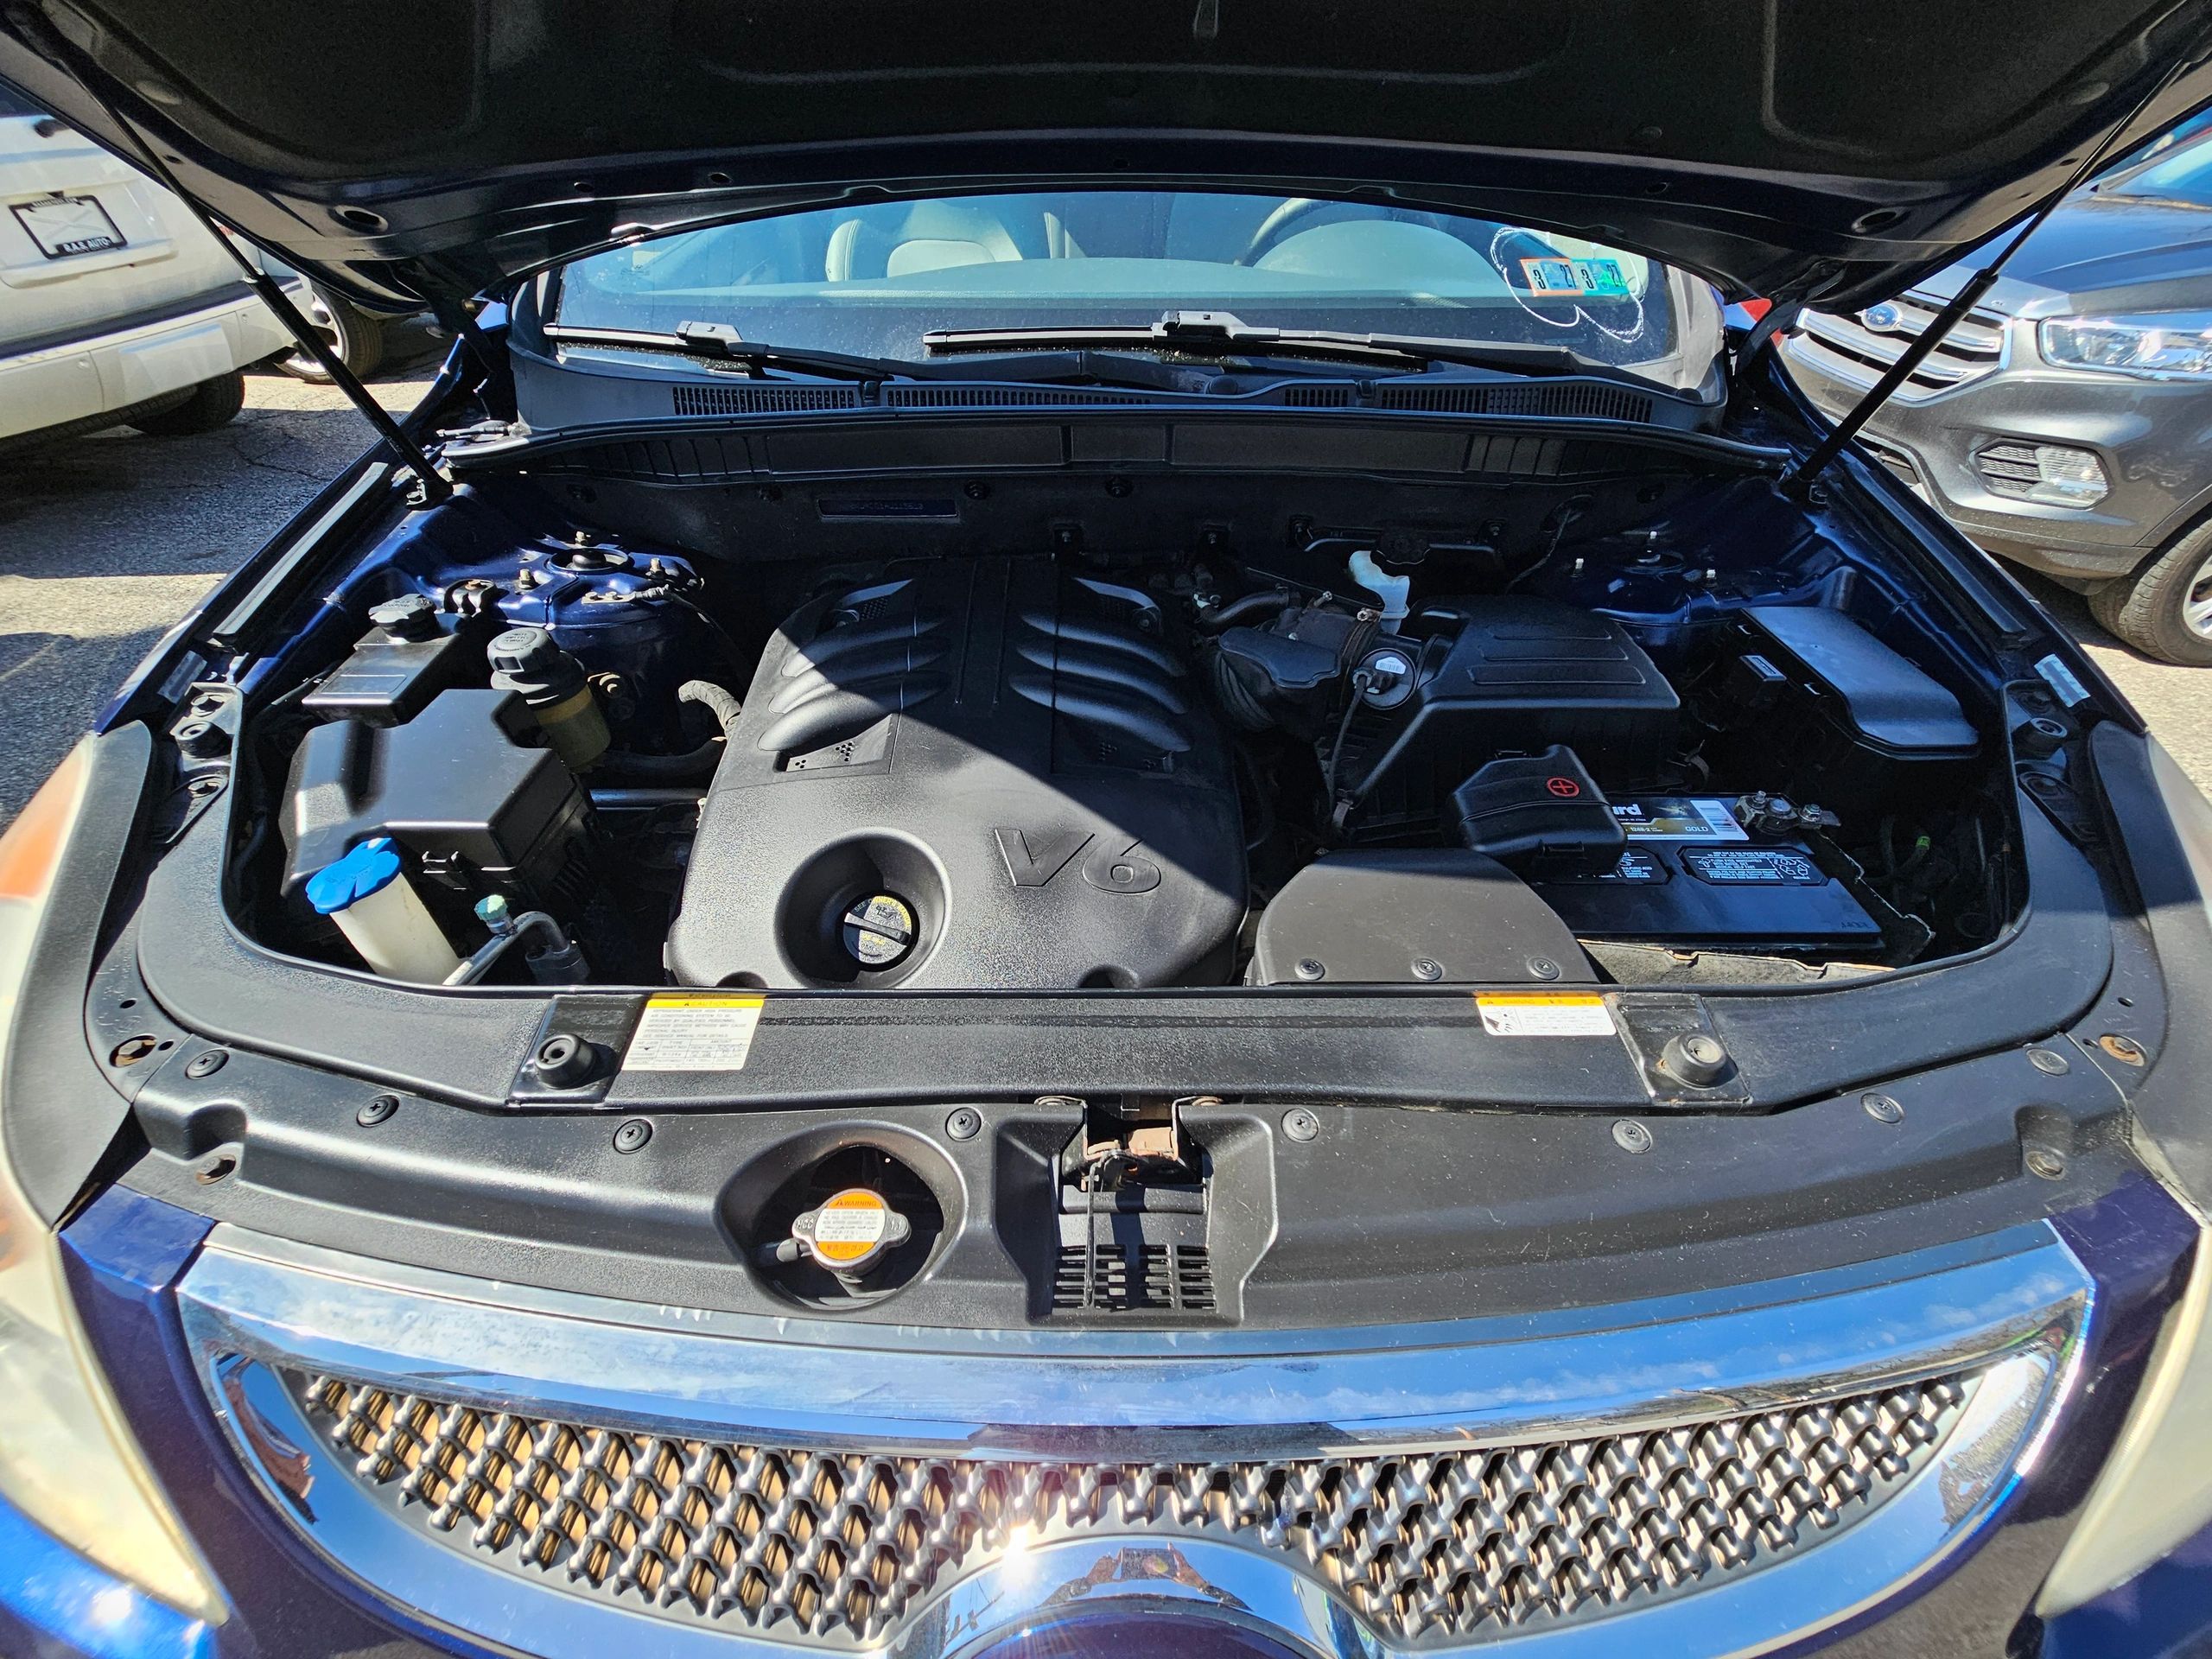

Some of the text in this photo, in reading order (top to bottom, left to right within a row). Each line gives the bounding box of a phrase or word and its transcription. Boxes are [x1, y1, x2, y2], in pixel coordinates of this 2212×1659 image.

[1533, 264, 1577, 289] 3 27
[1580, 269, 1594, 289] 3
[995, 826, 1161, 894] V6
